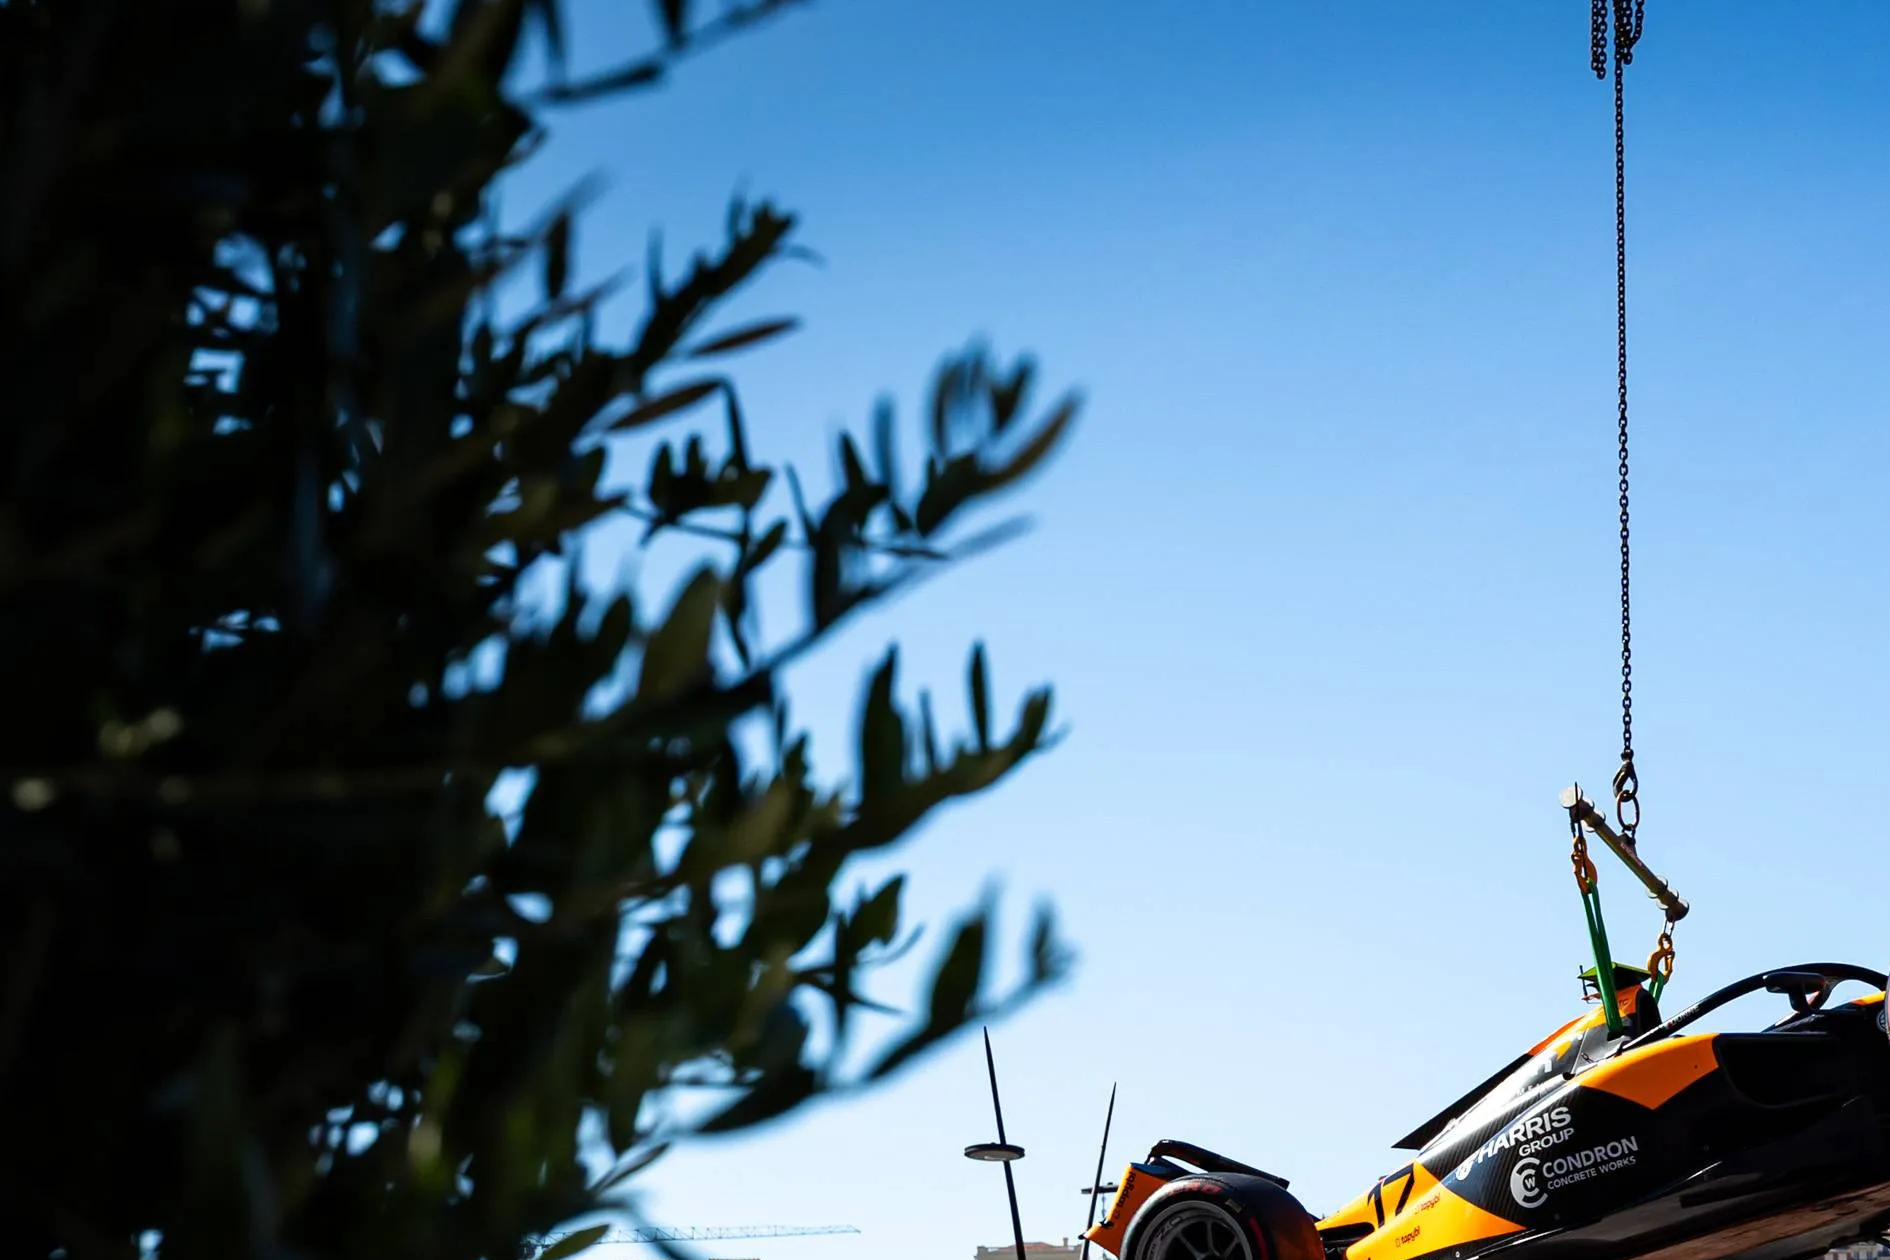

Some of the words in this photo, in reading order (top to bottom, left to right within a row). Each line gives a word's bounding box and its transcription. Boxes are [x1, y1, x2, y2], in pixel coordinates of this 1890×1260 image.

[1477, 1107, 1572, 1164] HARRIS
[1519, 1128, 1575, 1157] GROUP
[1542, 1136, 1639, 1178] CONDRON
[1547, 1166, 1598, 1190] CONCRETE
[1599, 1155, 1637, 1175] WORKS
[1367, 1162, 1415, 1229] 17
